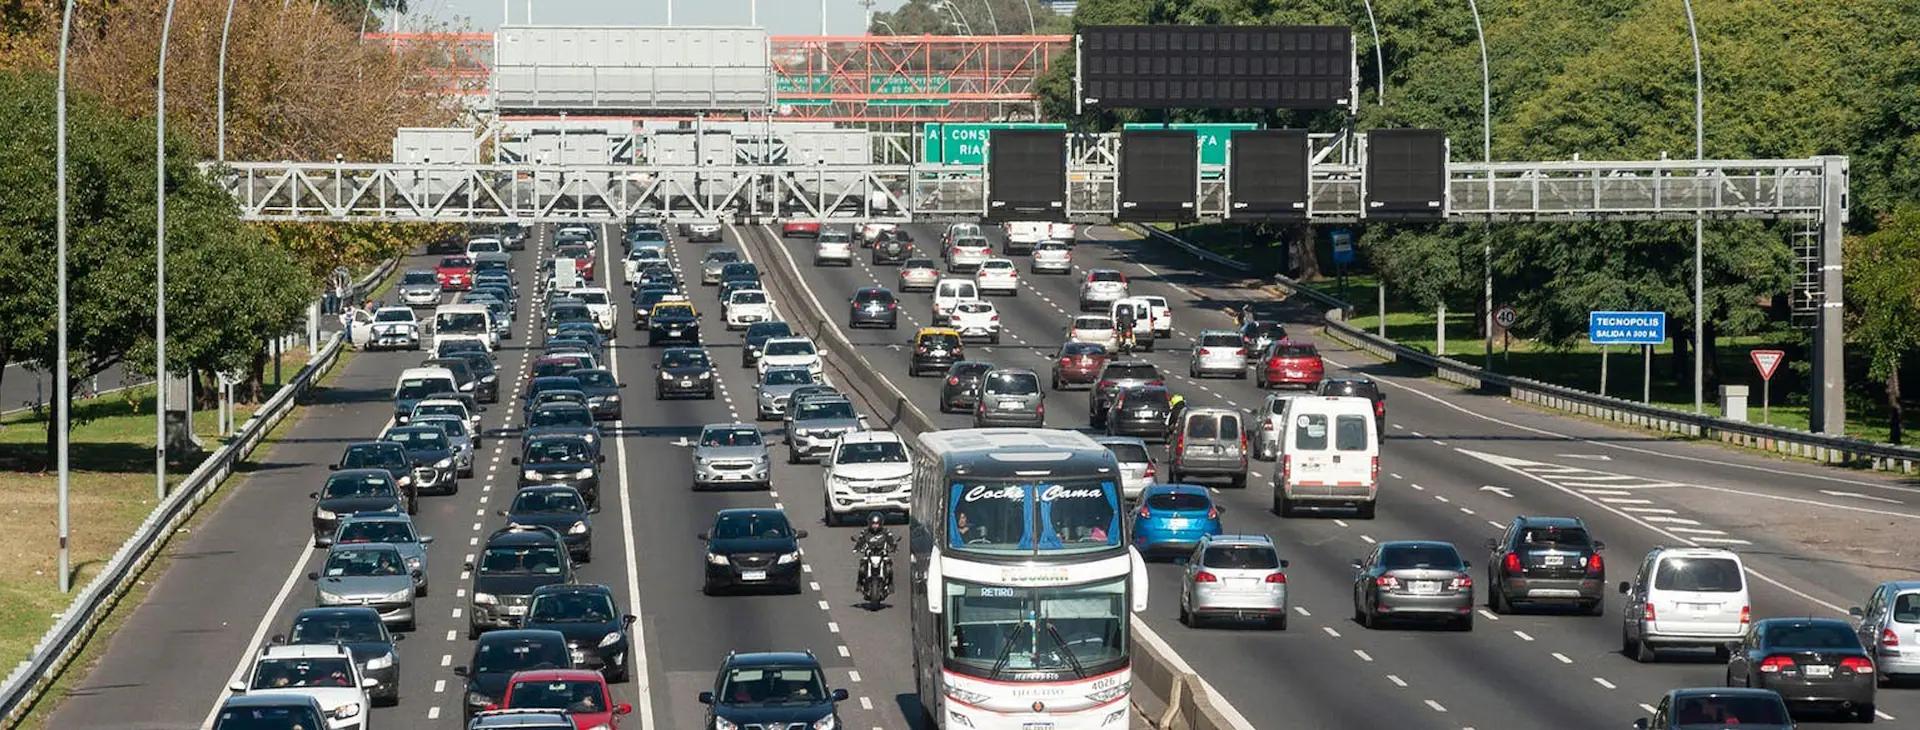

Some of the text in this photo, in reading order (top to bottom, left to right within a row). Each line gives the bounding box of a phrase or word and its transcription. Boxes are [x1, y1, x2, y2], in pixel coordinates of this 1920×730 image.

[1498, 310, 1514, 323] 40
[1596, 317, 1659, 327] TECNOPOLIS
[1596, 330, 1624, 338] SALIDA
[1626, 330, 1632, 338] A
[1041, 485, 1102, 502] Cama
[980, 587, 1014, 597] RETIRO
[1091, 678, 1116, 690] 4026
